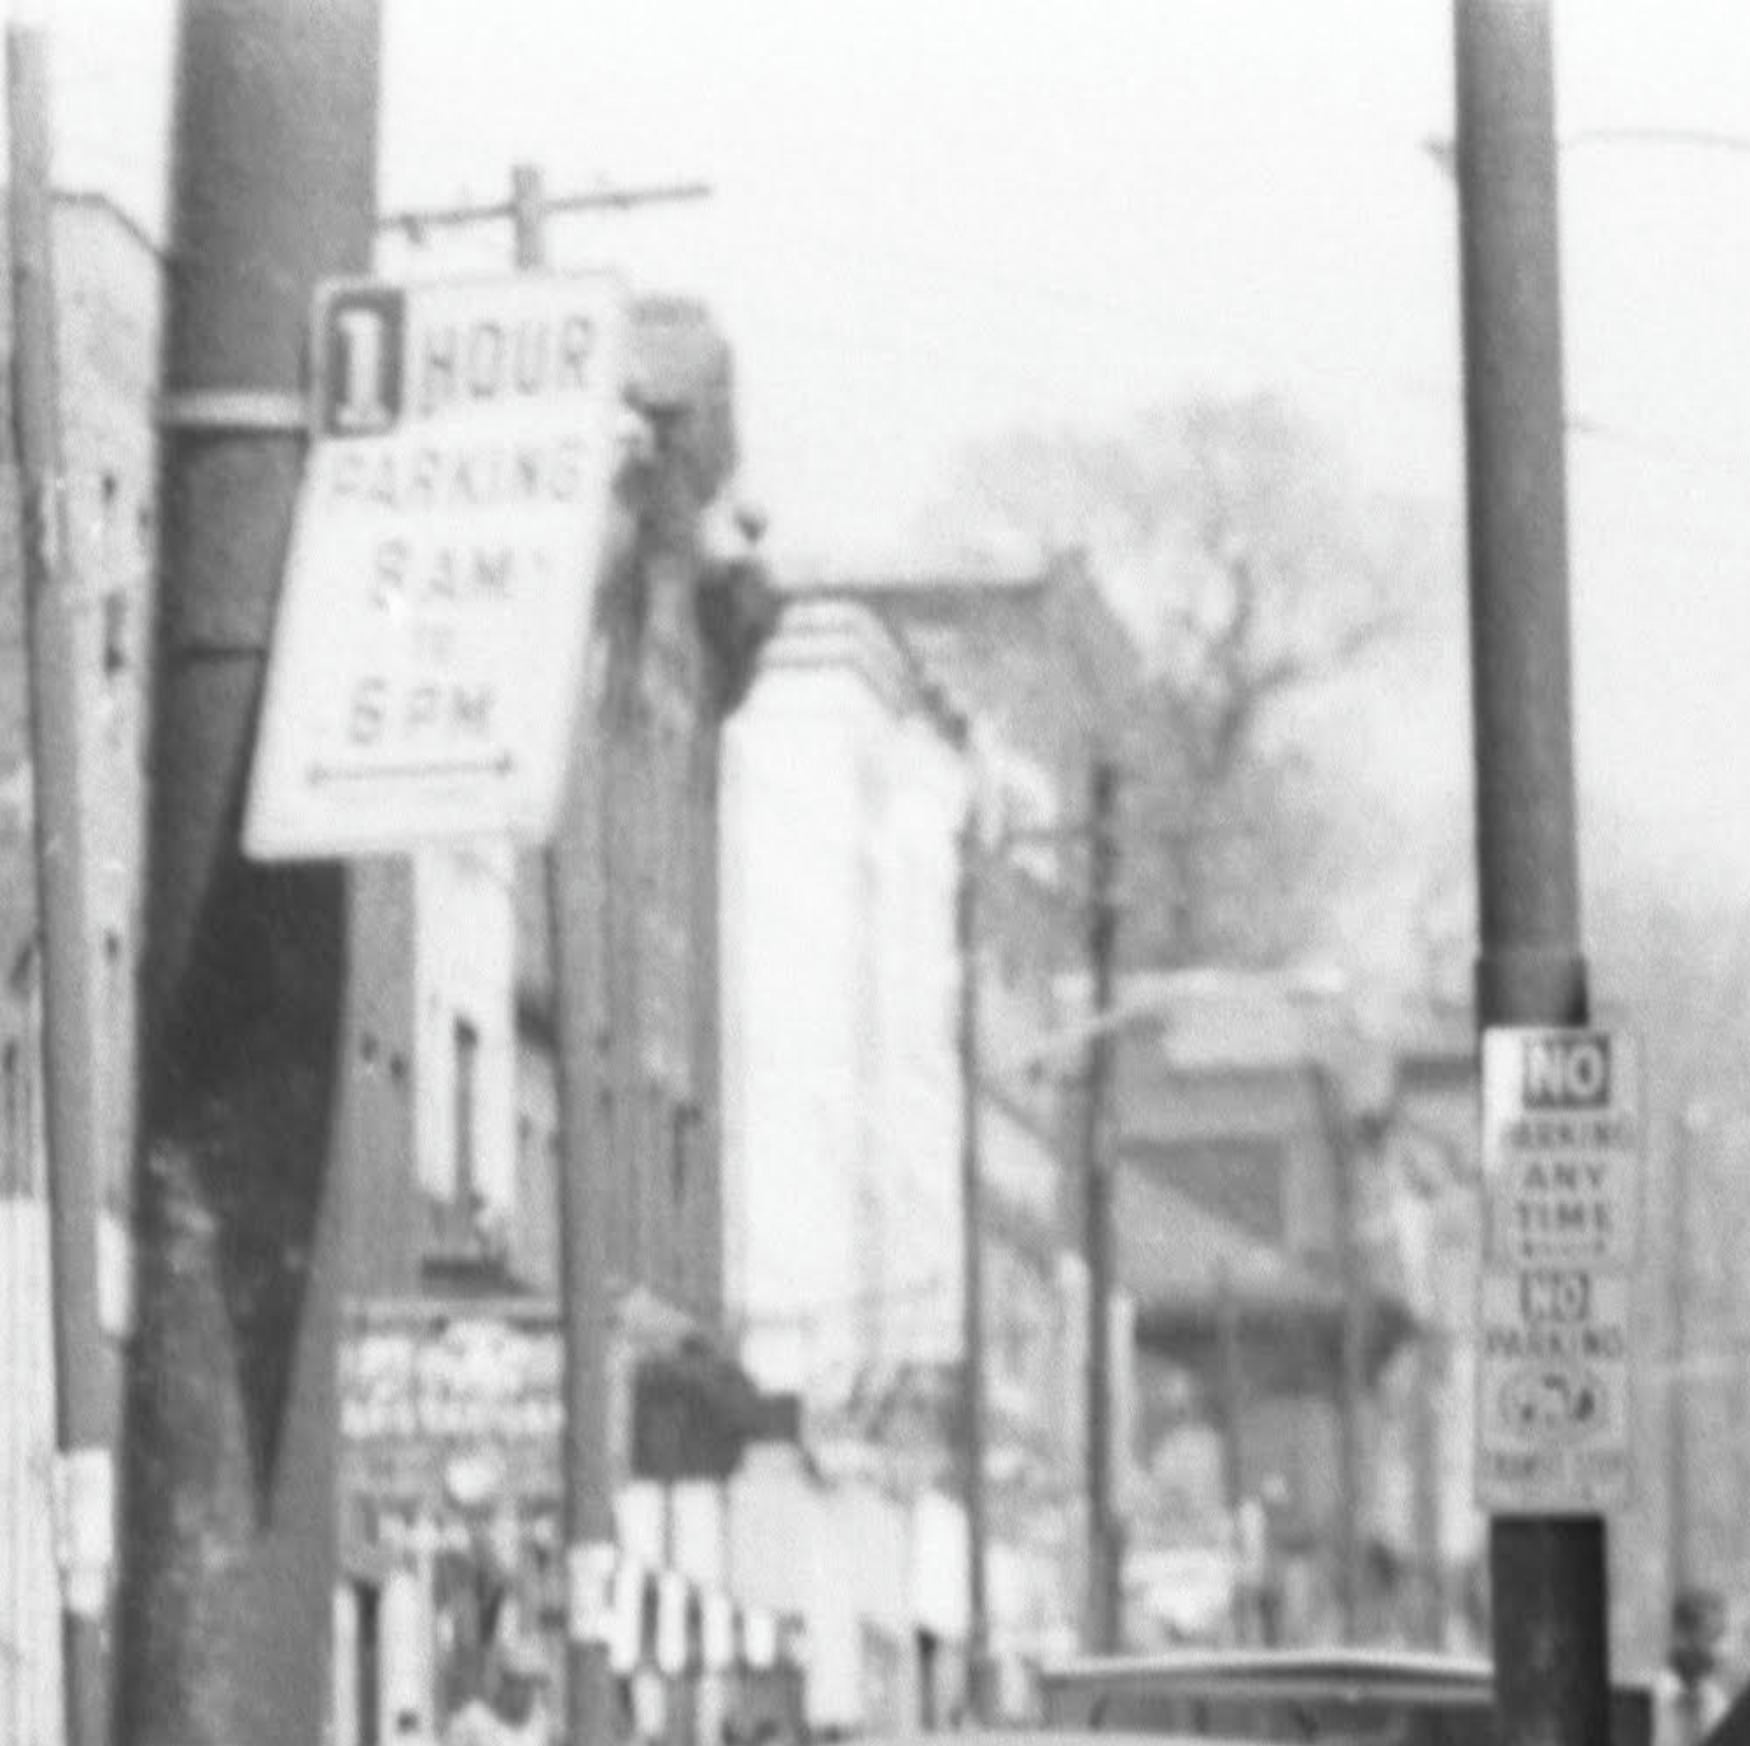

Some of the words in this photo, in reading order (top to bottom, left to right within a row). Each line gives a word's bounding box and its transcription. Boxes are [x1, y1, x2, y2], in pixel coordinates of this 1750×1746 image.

[334, 306, 396, 432] 1
[418, 313, 600, 418] HOUR
[328, 437, 588, 511] PARKING
[1526, 1044, 1604, 1102] NO
[1522, 1163, 1608, 1191] ANY
[1515, 1201, 1612, 1234] TIME
